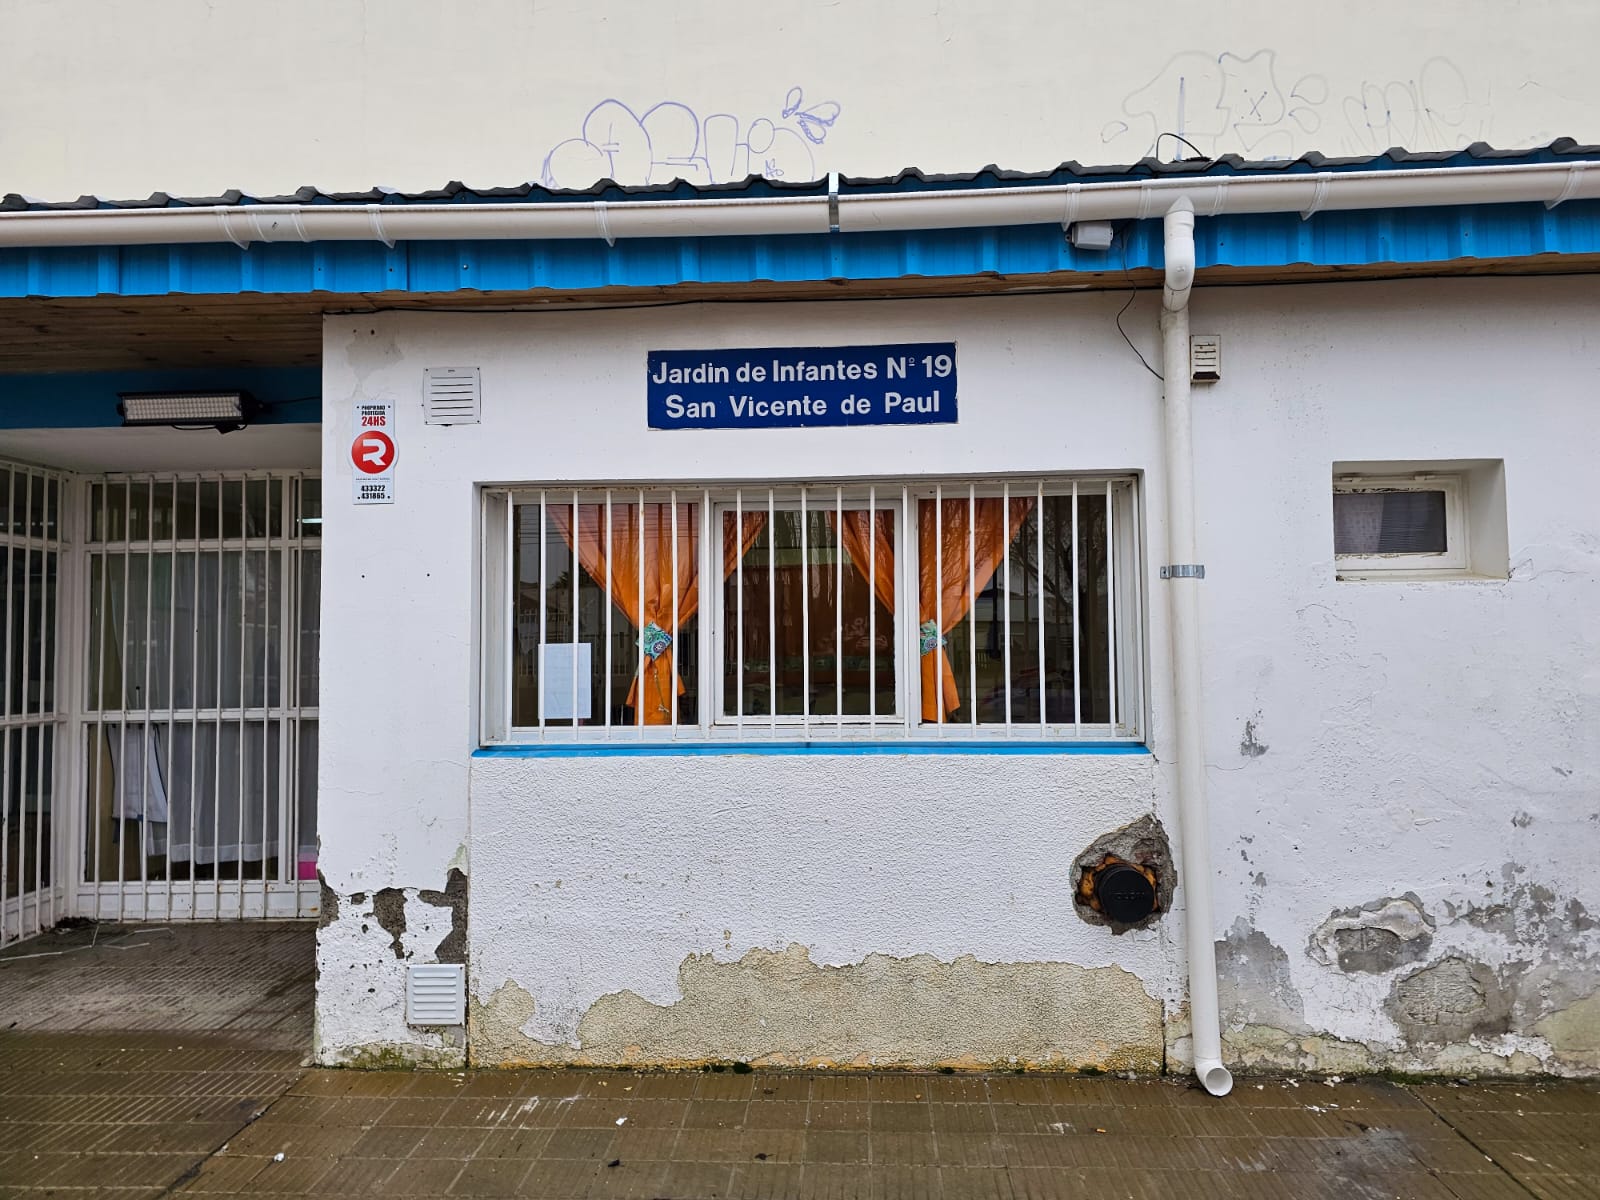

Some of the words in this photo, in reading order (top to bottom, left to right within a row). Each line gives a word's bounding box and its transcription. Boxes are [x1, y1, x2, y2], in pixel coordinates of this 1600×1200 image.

[652, 361, 729, 384] Jardin
[735, 362, 767, 383] de
[773, 359, 878, 382] Infantes
[922, 355, 952, 378] 19
[666, 395, 716, 418] San
[728, 395, 828, 417] Vicente
[840, 395, 871, 415] de
[884, 391, 940, 413] Paul
[361, 416, 386, 426] 24HS
